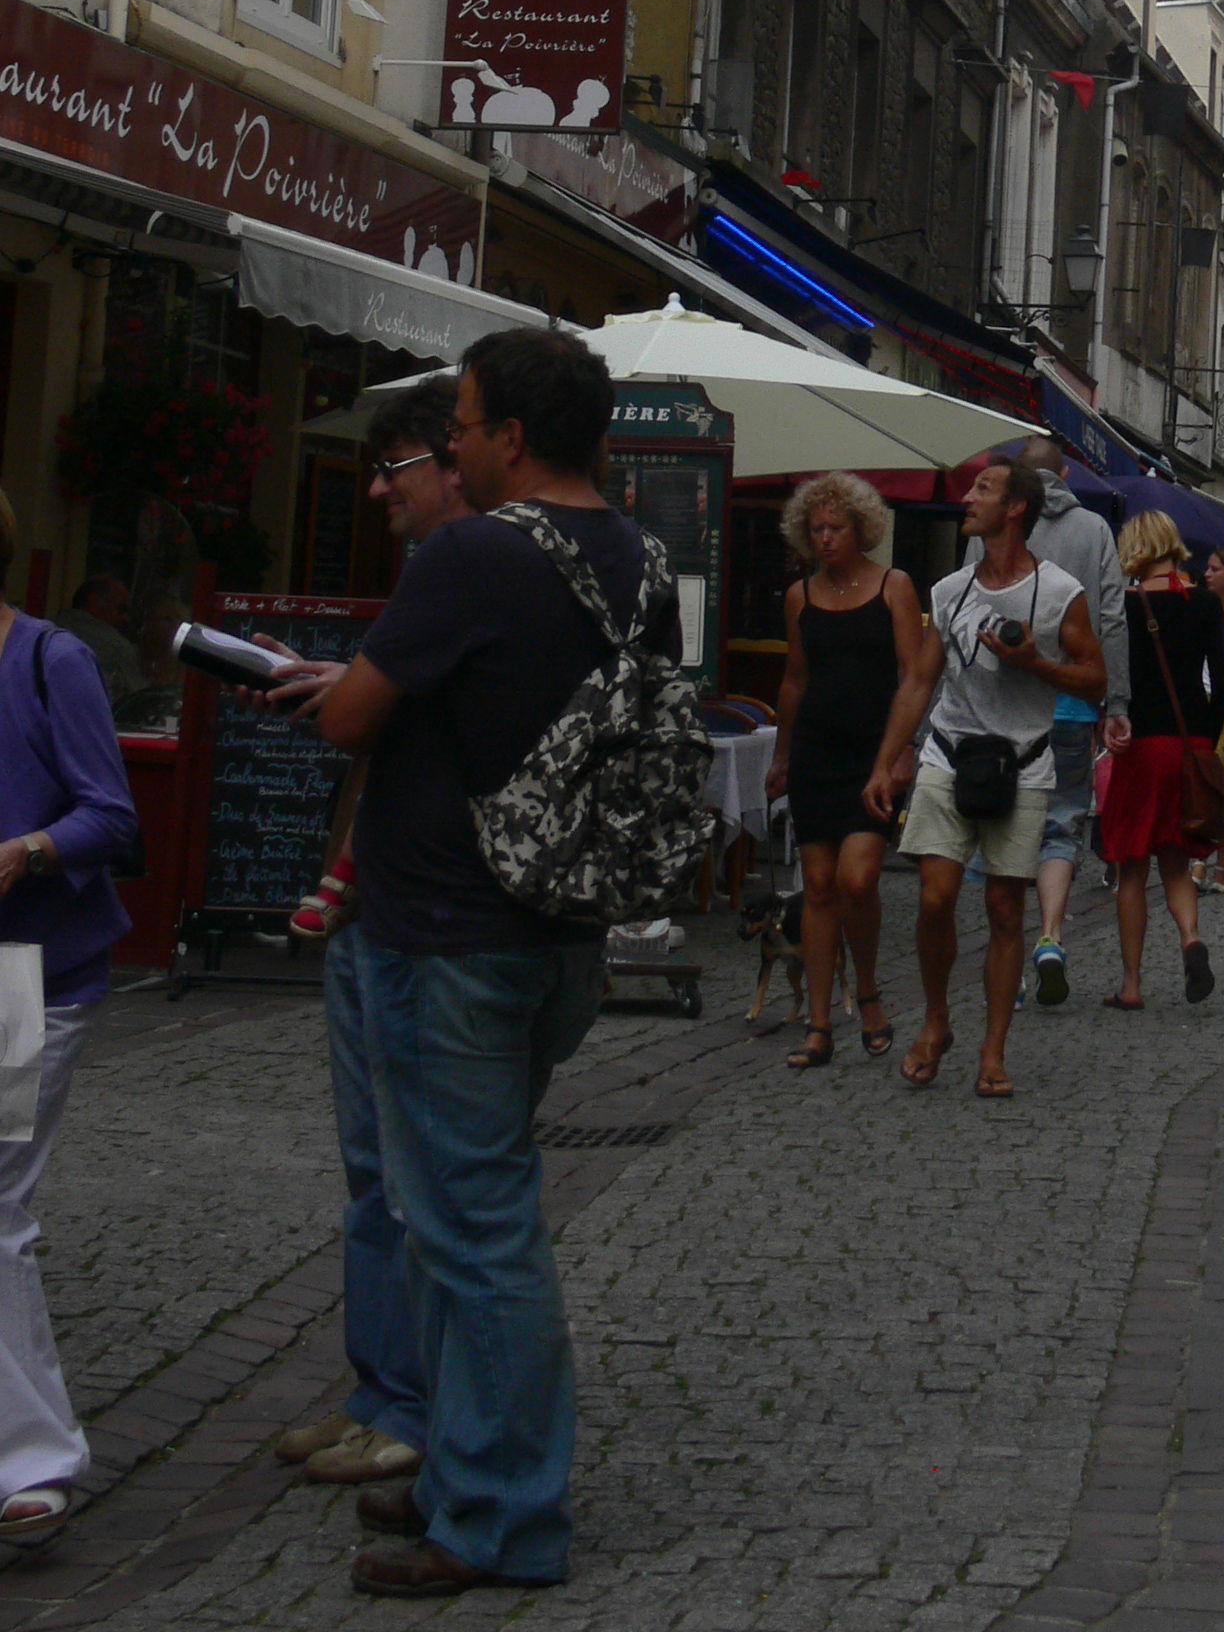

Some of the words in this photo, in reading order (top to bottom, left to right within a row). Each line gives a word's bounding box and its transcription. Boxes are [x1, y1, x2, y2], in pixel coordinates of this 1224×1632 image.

[0, 60, 135, 138] aurant
[363, 291, 451, 349] Restaurant
[611, 402, 671, 422] IÈRE
